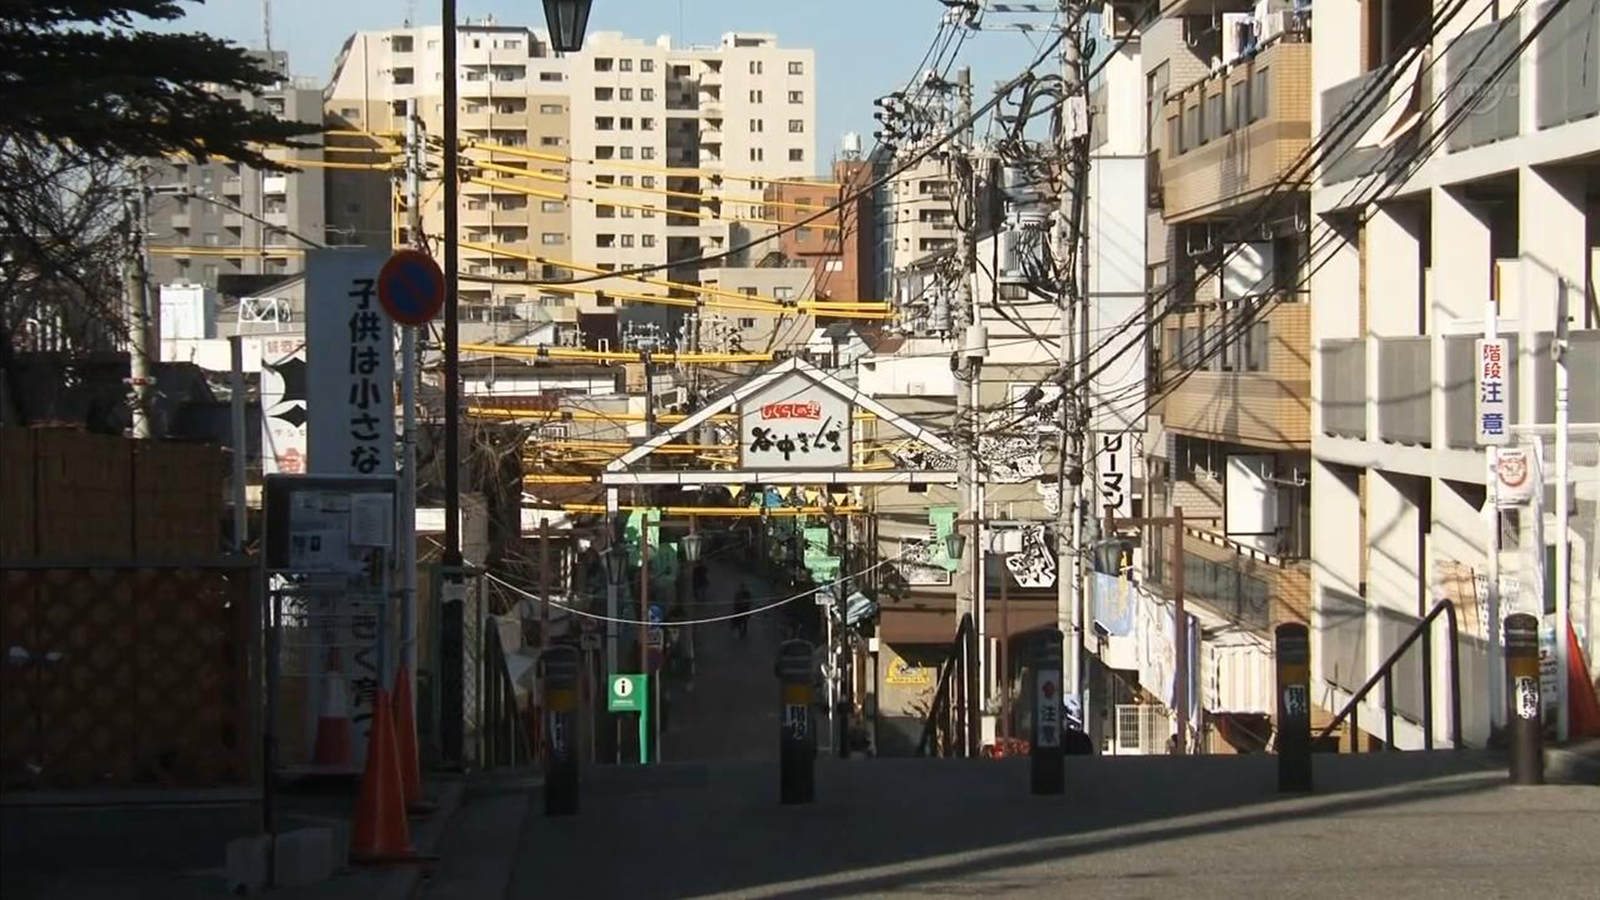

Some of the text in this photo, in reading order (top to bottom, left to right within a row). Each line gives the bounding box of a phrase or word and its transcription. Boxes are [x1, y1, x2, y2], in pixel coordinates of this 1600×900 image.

[348, 278, 381, 474] 子供は小さな
[1481, 344, 1503, 435] 階段注意
[749, 416, 842, 461] 谷中ぎんざ
